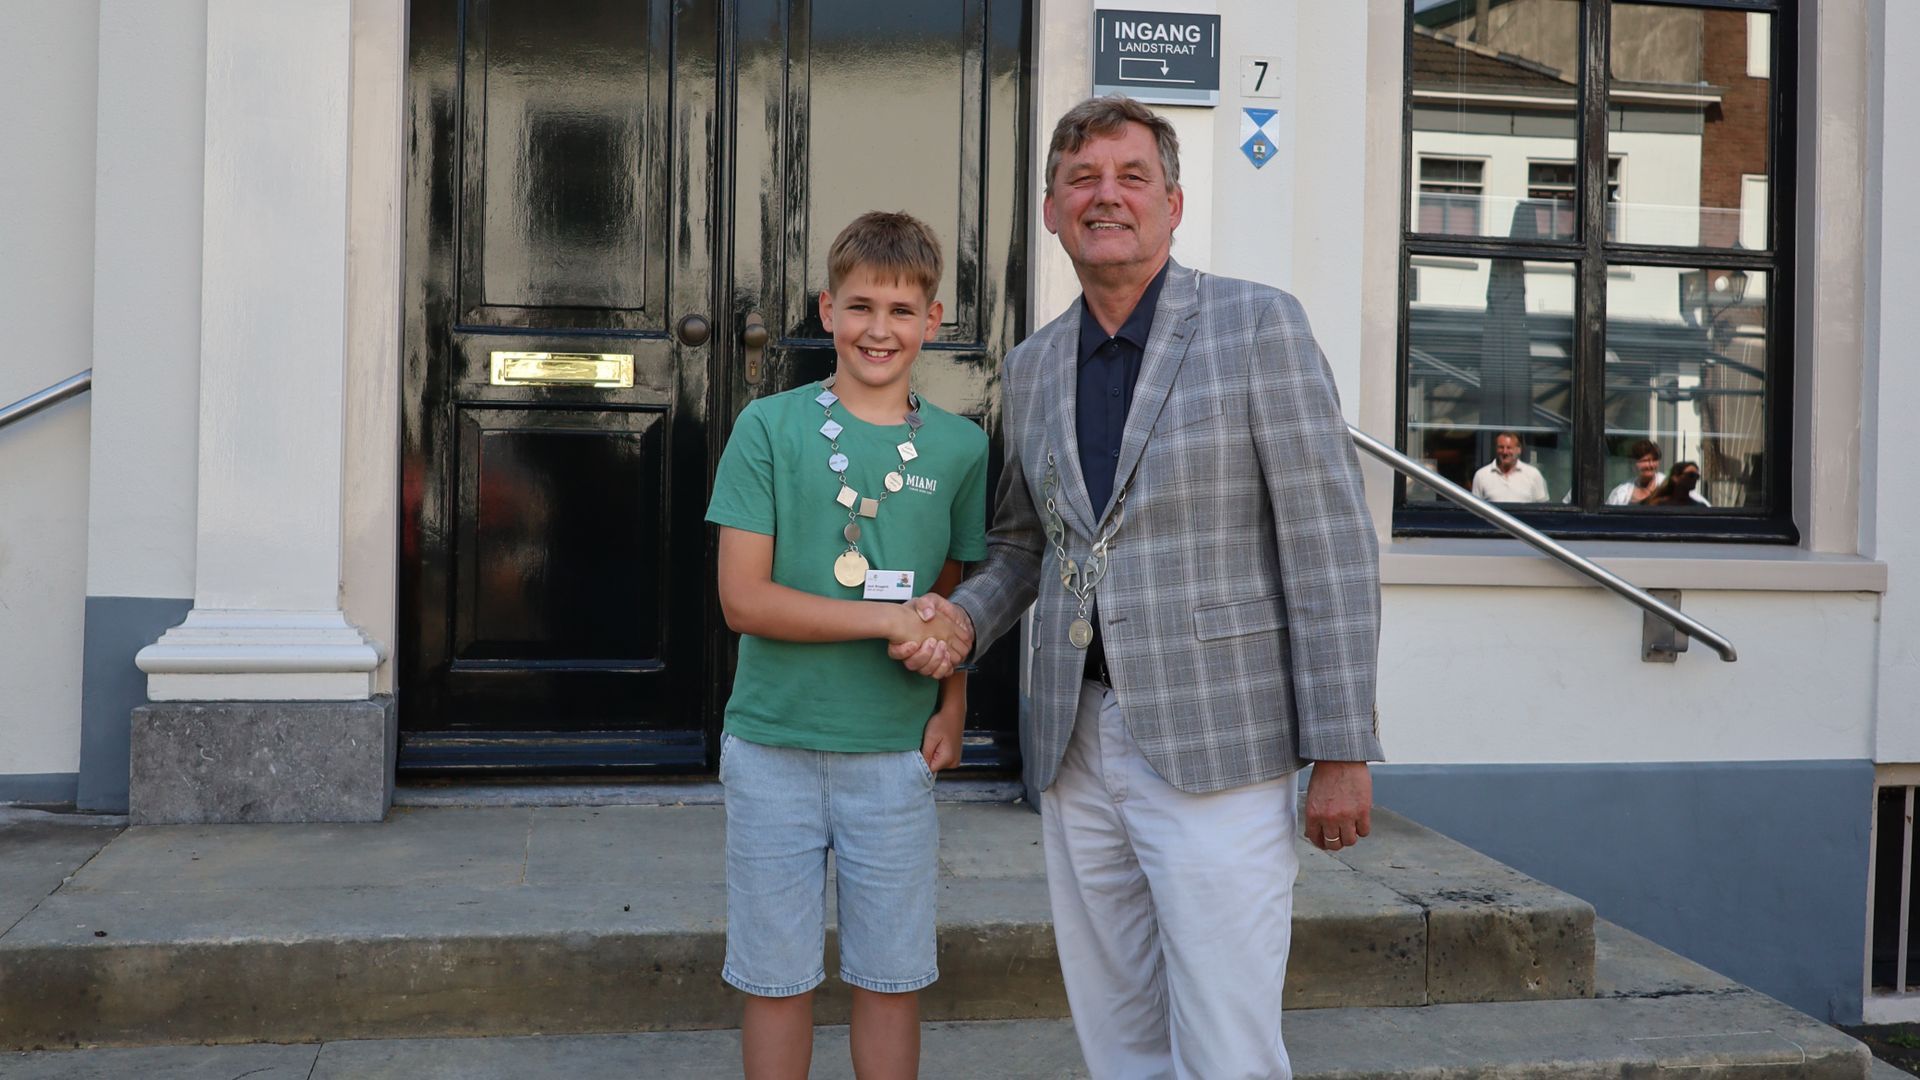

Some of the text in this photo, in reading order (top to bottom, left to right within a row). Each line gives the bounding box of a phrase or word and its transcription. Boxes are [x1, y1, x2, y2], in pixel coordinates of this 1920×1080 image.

[1115, 21, 1201, 43] INGANG
[1119, 41, 1197, 55] LANDSTRAAT
[1254, 61, 1269, 92] 7
[906, 473, 937, 492] MIAMI
